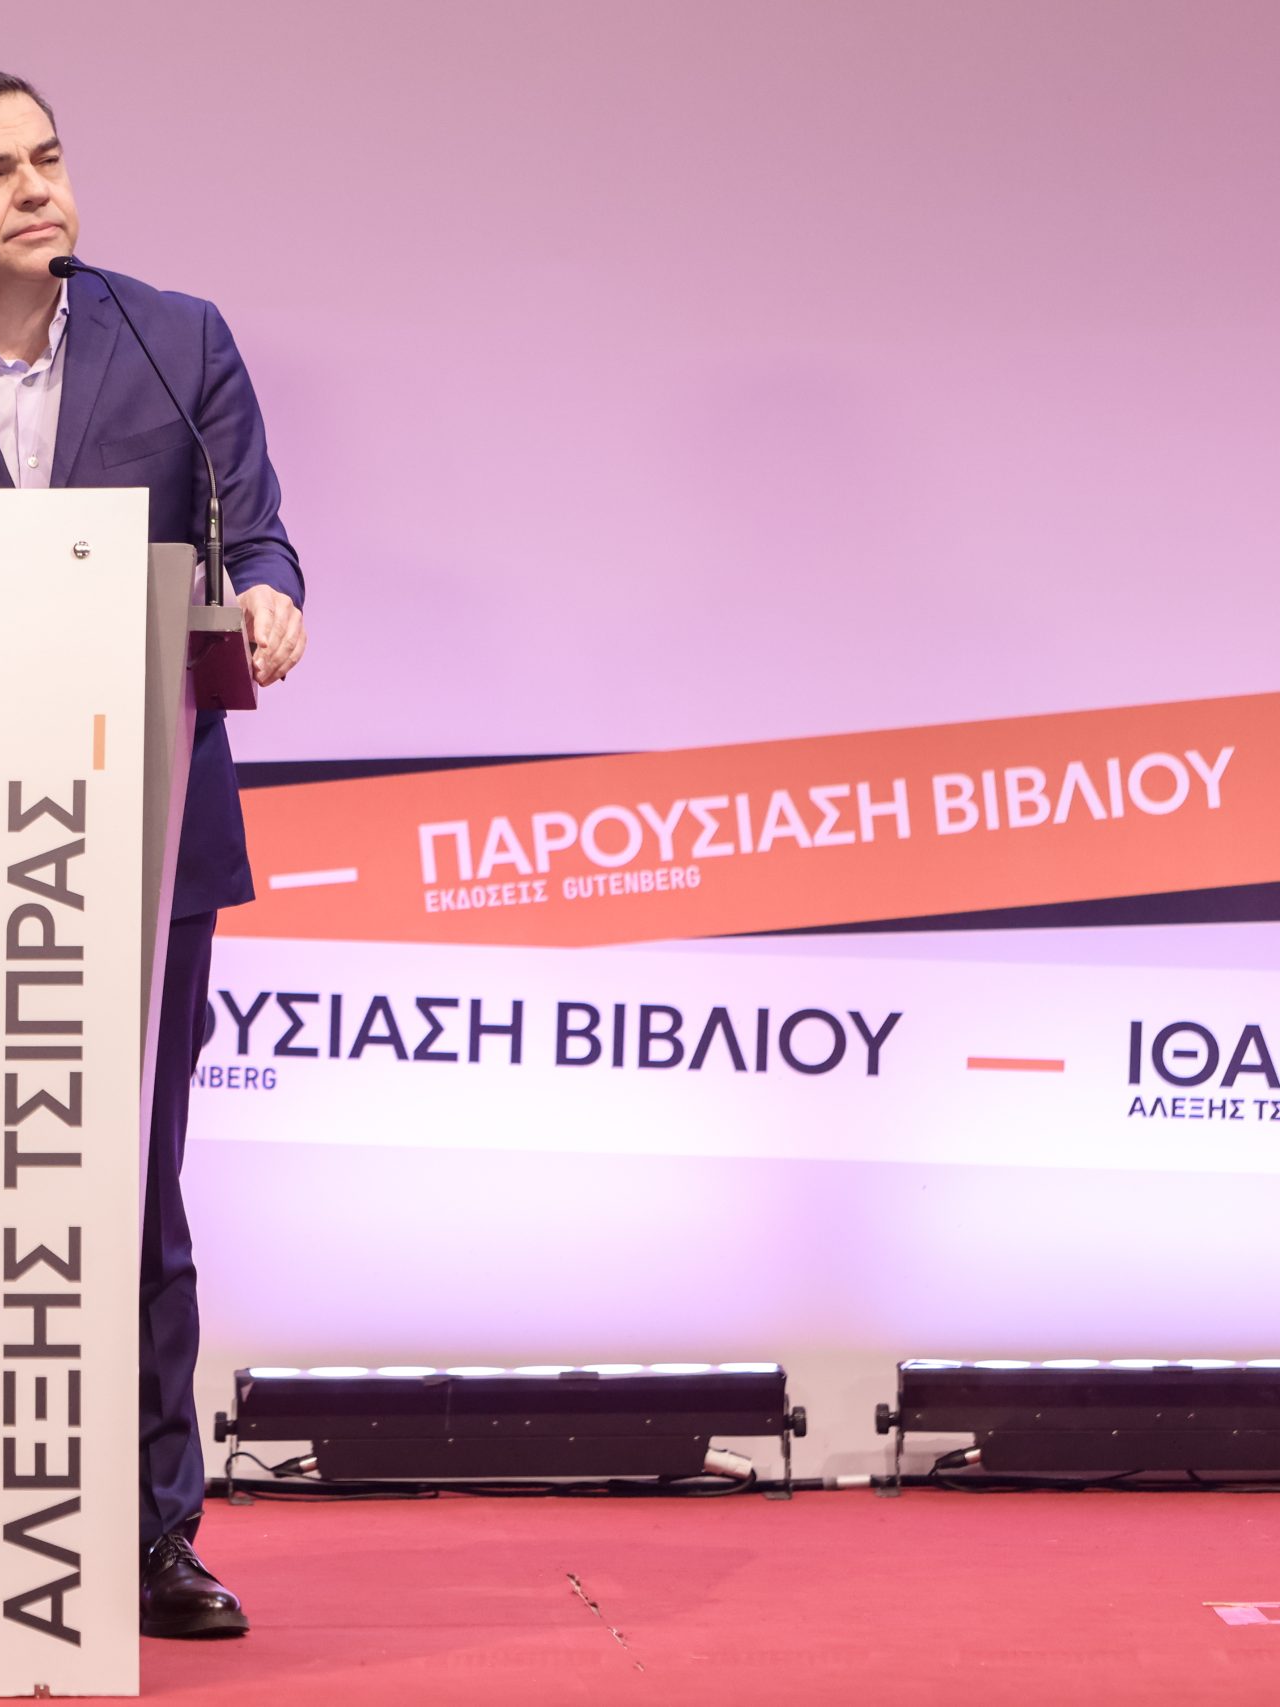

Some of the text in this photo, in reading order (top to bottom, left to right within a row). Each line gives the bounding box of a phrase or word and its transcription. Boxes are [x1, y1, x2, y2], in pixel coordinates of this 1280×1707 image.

[418, 746, 1235, 884] ΠΑΡΟΥΣΙΑΣΗ ΒΙΒΛΙΟΥ
[424, 865, 701, 912] ΕΚΔΟΣΕΙΣ GUTENBERG
[203, 990, 903, 1077] ΥΣΙΑΣΗ ΒΙΒΛΙΟΥ
[1127, 1096, 1245, 1120] ΑΛΕΞΗΣ
[3, 779, 87, 1648] ΑΛΕΞΗΣ ΤΣΙΠΡΑΣ
